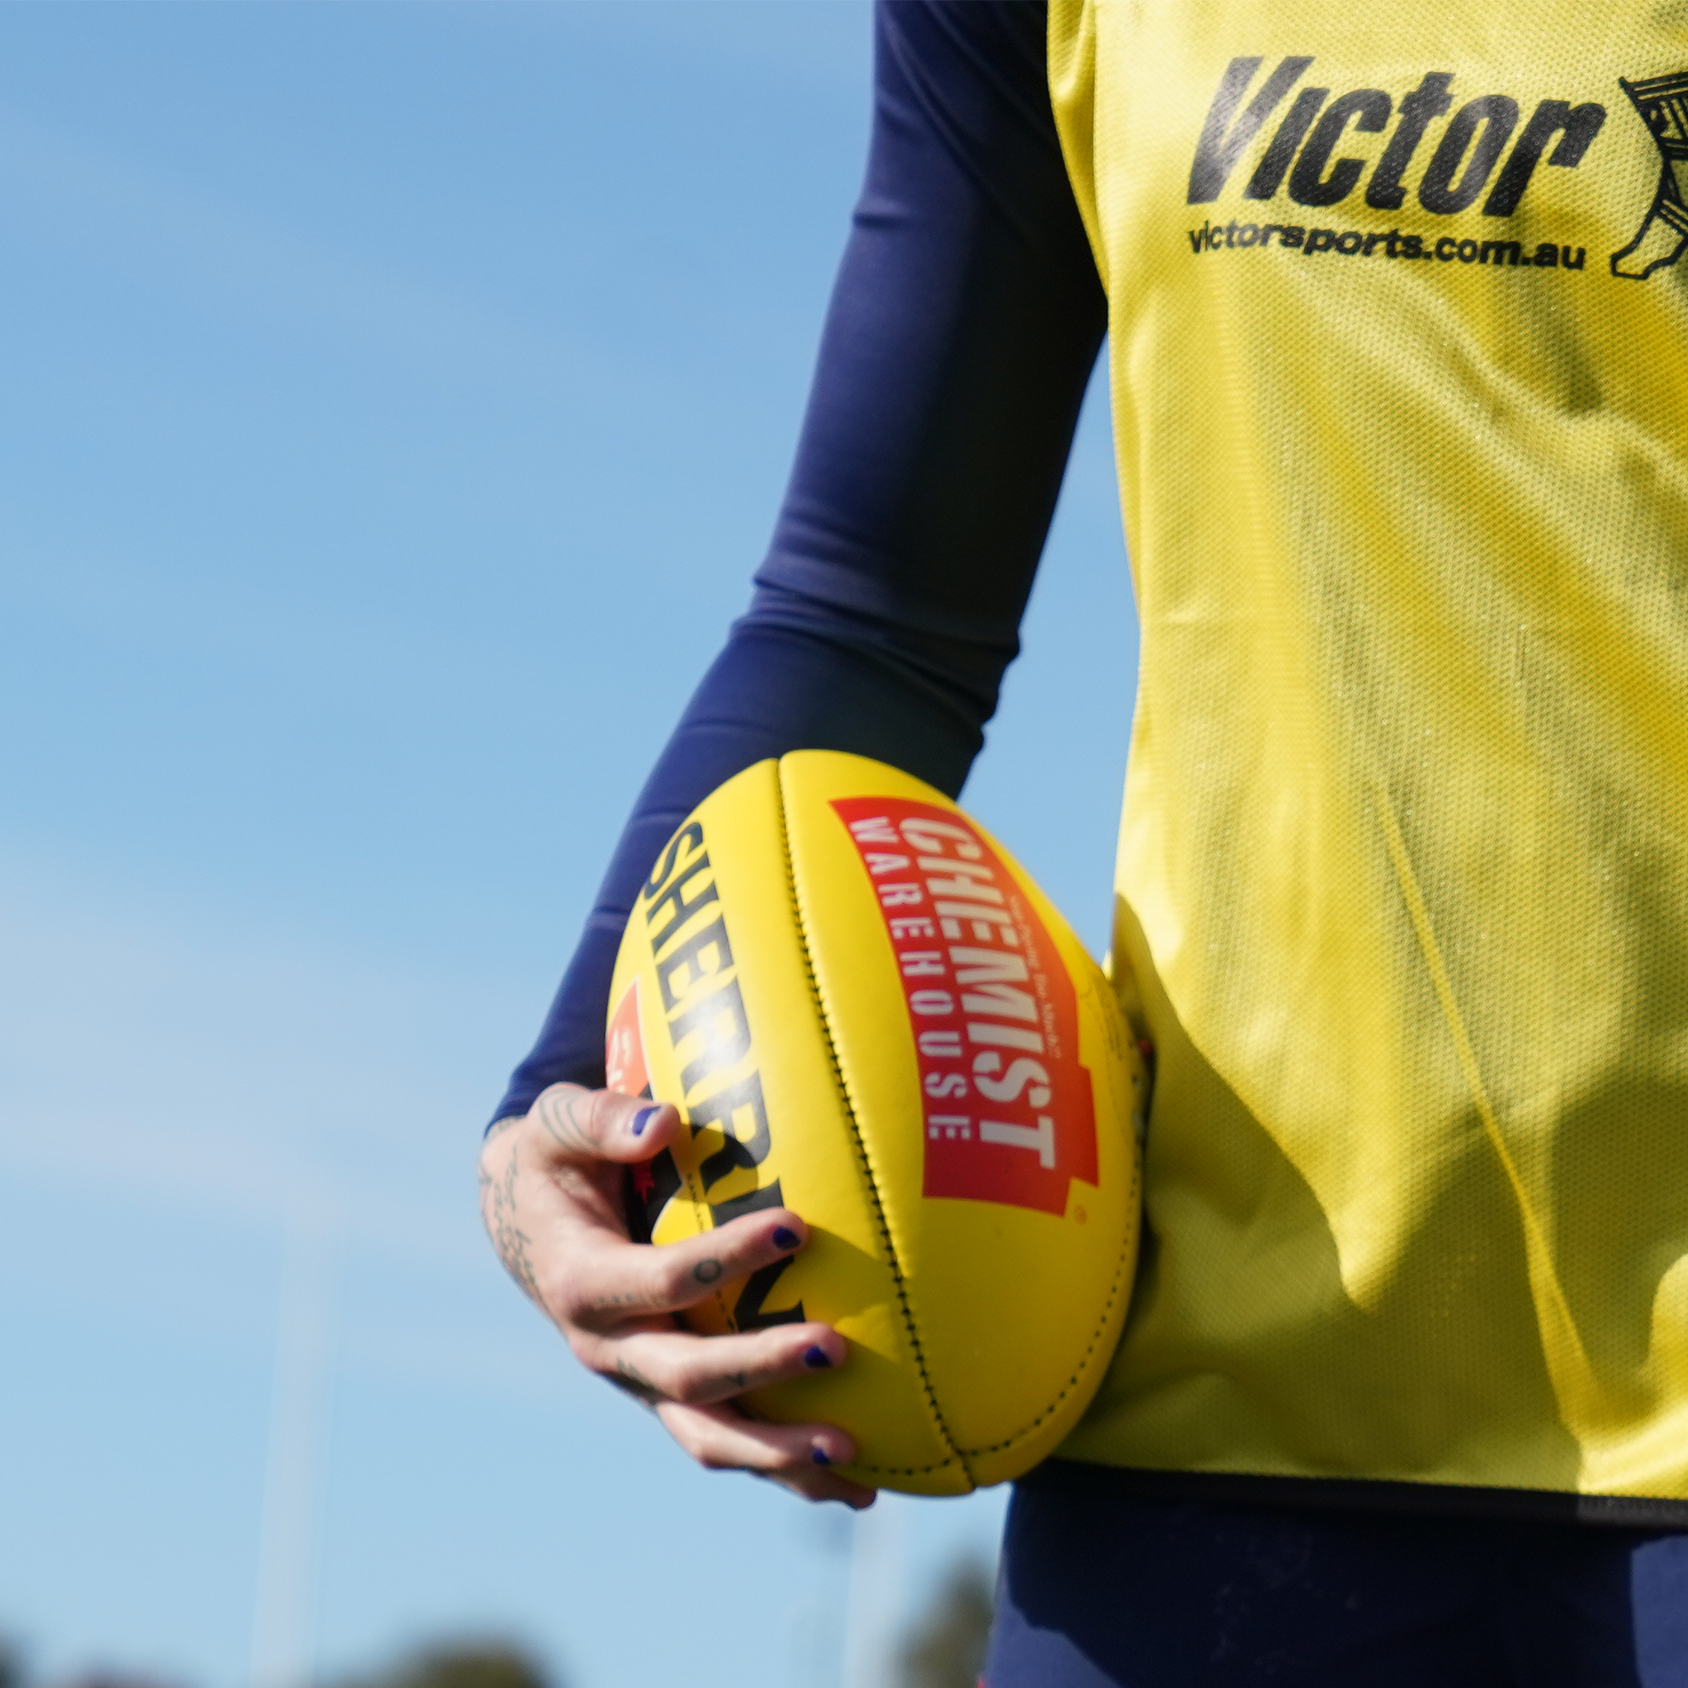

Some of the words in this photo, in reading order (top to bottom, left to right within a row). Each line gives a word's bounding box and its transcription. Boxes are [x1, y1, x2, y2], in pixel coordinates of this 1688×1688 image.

[1186, 55, 1607, 218] Victor
[1187, 219, 1587, 271] victorsports.com.au
[850, 816, 971, 1141] WAREHOUSE
[900, 816, 1056, 1170] CHEMIST
